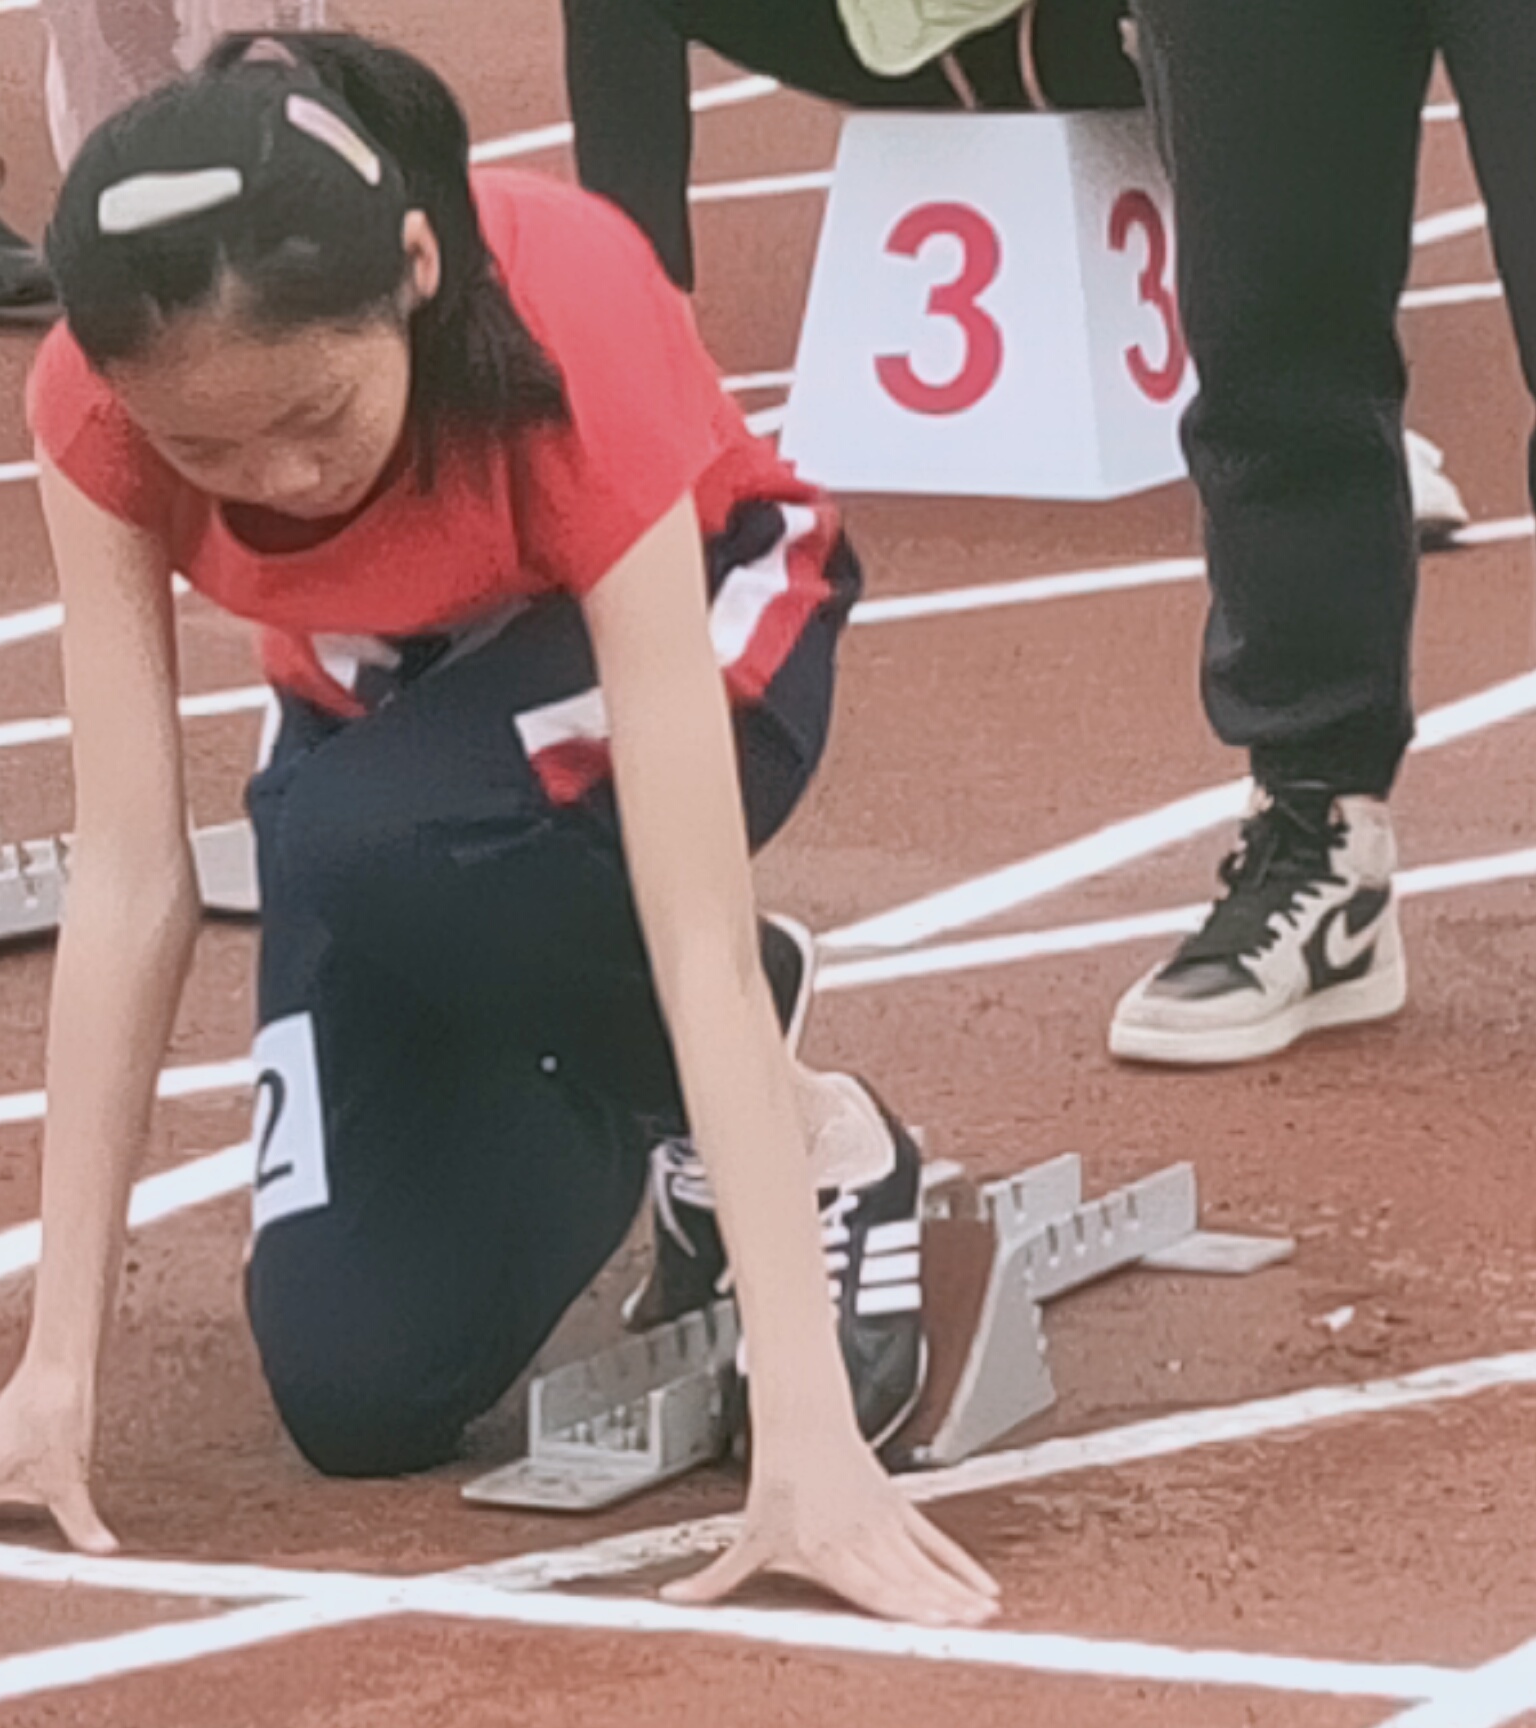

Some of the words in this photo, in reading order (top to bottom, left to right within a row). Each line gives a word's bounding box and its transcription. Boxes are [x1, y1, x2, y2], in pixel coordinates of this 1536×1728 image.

[873, 199, 1004, 415] 3
[1108, 187, 1188, 404] 3
[257, 1068, 293, 1191] 2
